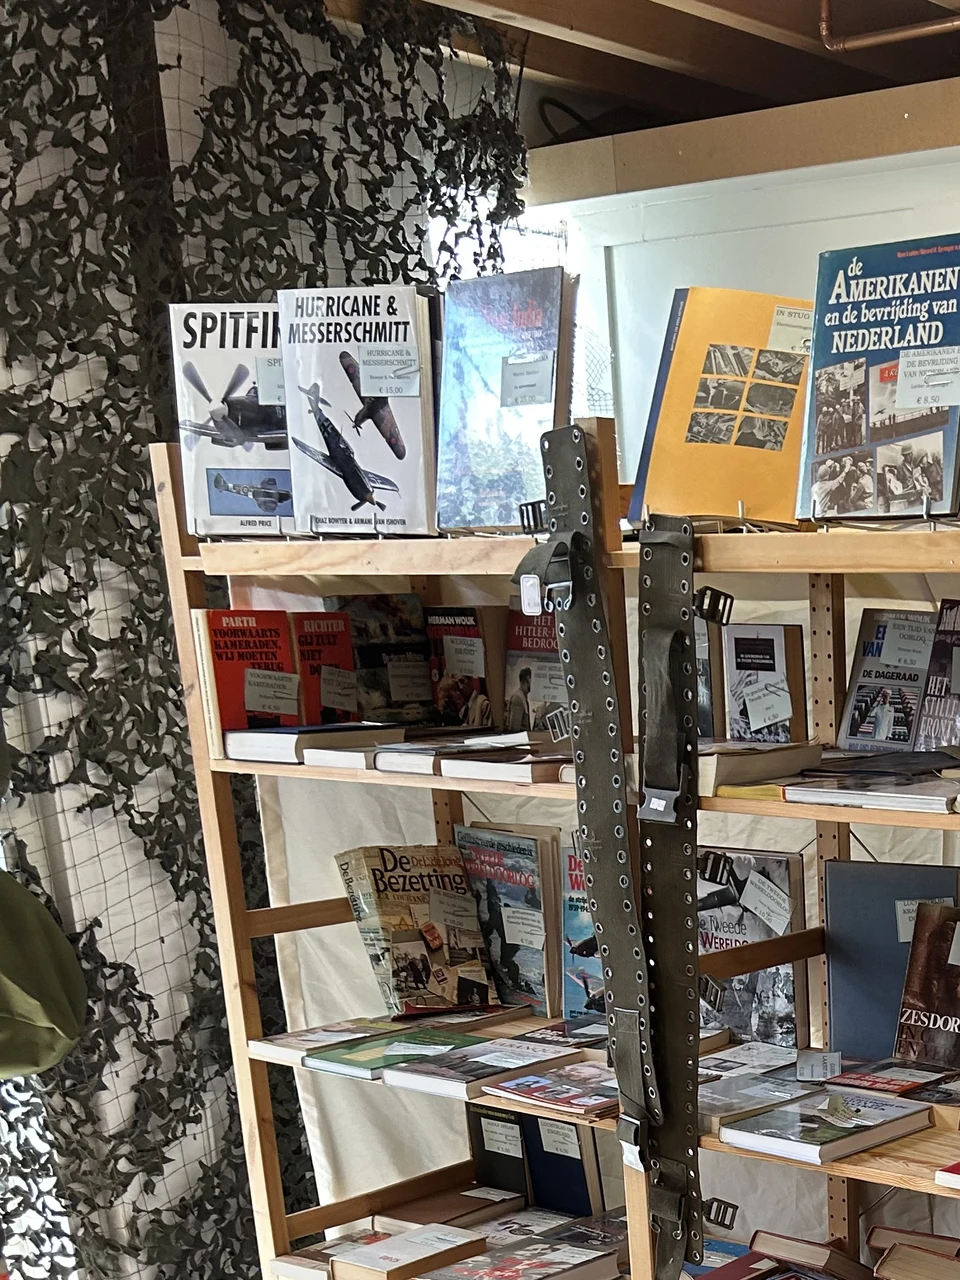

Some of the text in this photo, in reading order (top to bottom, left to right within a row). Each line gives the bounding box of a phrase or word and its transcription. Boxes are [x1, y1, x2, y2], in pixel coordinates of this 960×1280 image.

[848, 256, 863, 277] de
[828, 266, 960, 305] AMERIKANEN
[295, 295, 398, 318] HURRICANE &
[824, 298, 957, 326] en de bevrijding van
[183, 312, 281, 349] SPITFI
[288, 321, 410, 344] MESSERSCHMITT
[831, 321, 944, 354] NEDERLAND
[366, 349, 404, 357] HURRICANE
[385, 386, 403, 395] 15,00
[923, 396, 940, 405] 8,50
[222, 616, 256, 627] PARTH
[304, 620, 346, 632] RICHTER
[428, 616, 475, 625] HERMAN WOUK
[534, 616, 551, 625] HET
[212, 628, 280, 639] VOORWAARTS
[237, 651, 277, 660] MOETEN
[862, 670, 919, 682] DE DAGERAAD
[379, 848, 411, 872] De
[371, 868, 467, 895] Bezetting
[901, 1008, 928, 1028] ZES
